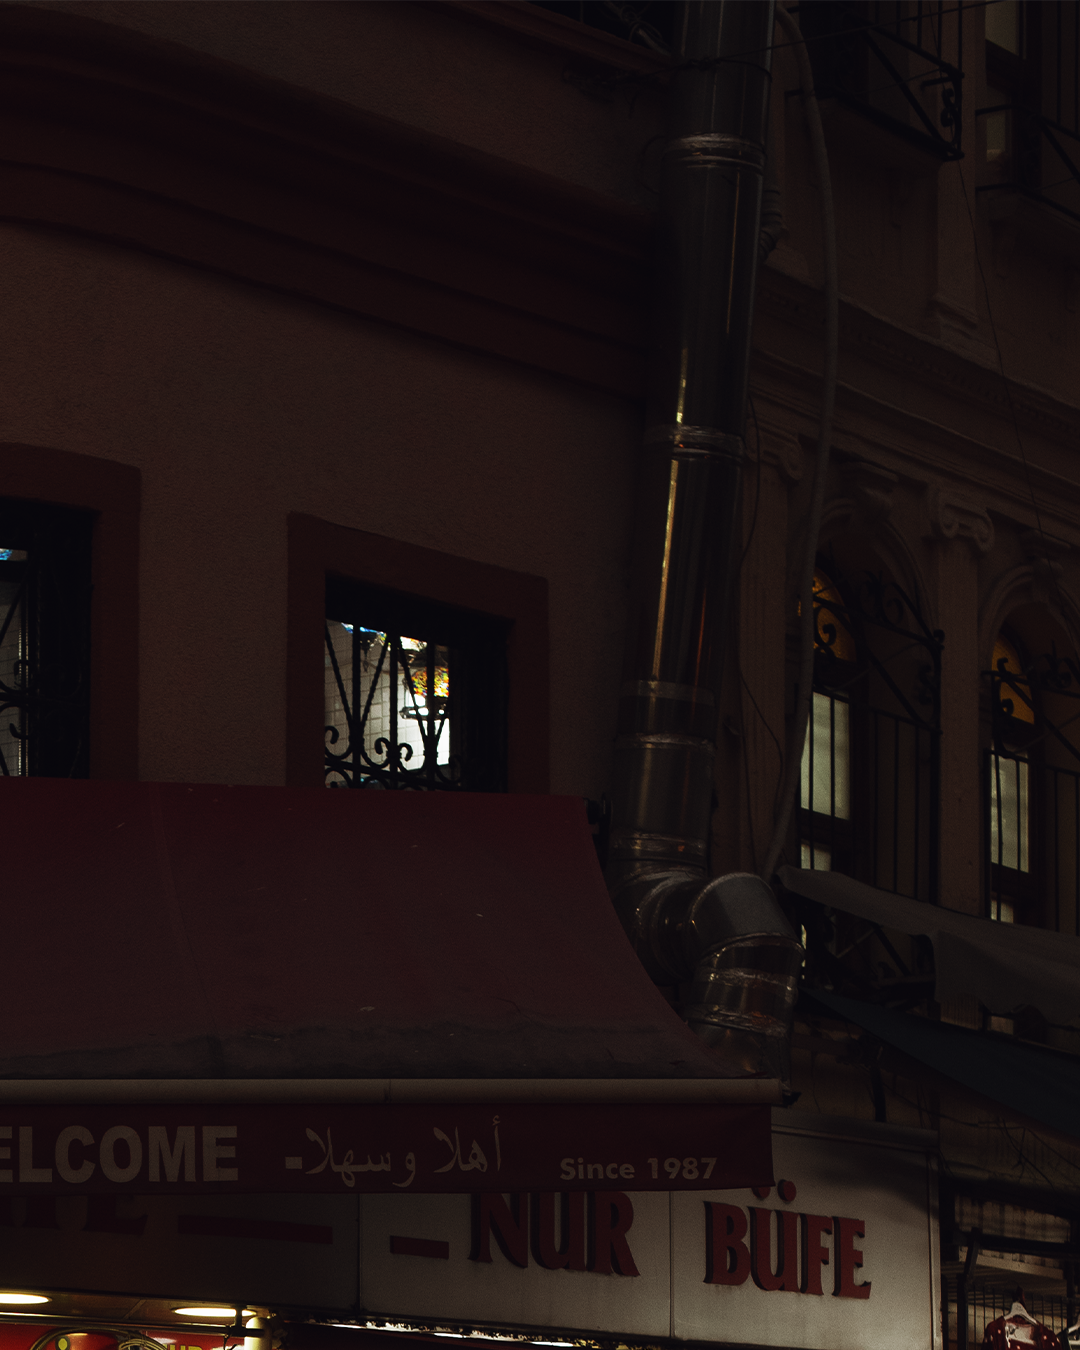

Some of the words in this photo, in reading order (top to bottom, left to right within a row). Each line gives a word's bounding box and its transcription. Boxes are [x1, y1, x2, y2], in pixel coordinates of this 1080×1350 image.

[560, 1157, 635, 1181] Since
[647, 1157, 717, 1180] 1987
[467, 1190, 641, 1277] NUR
[702, 1179, 872, 1300] BÜFE
